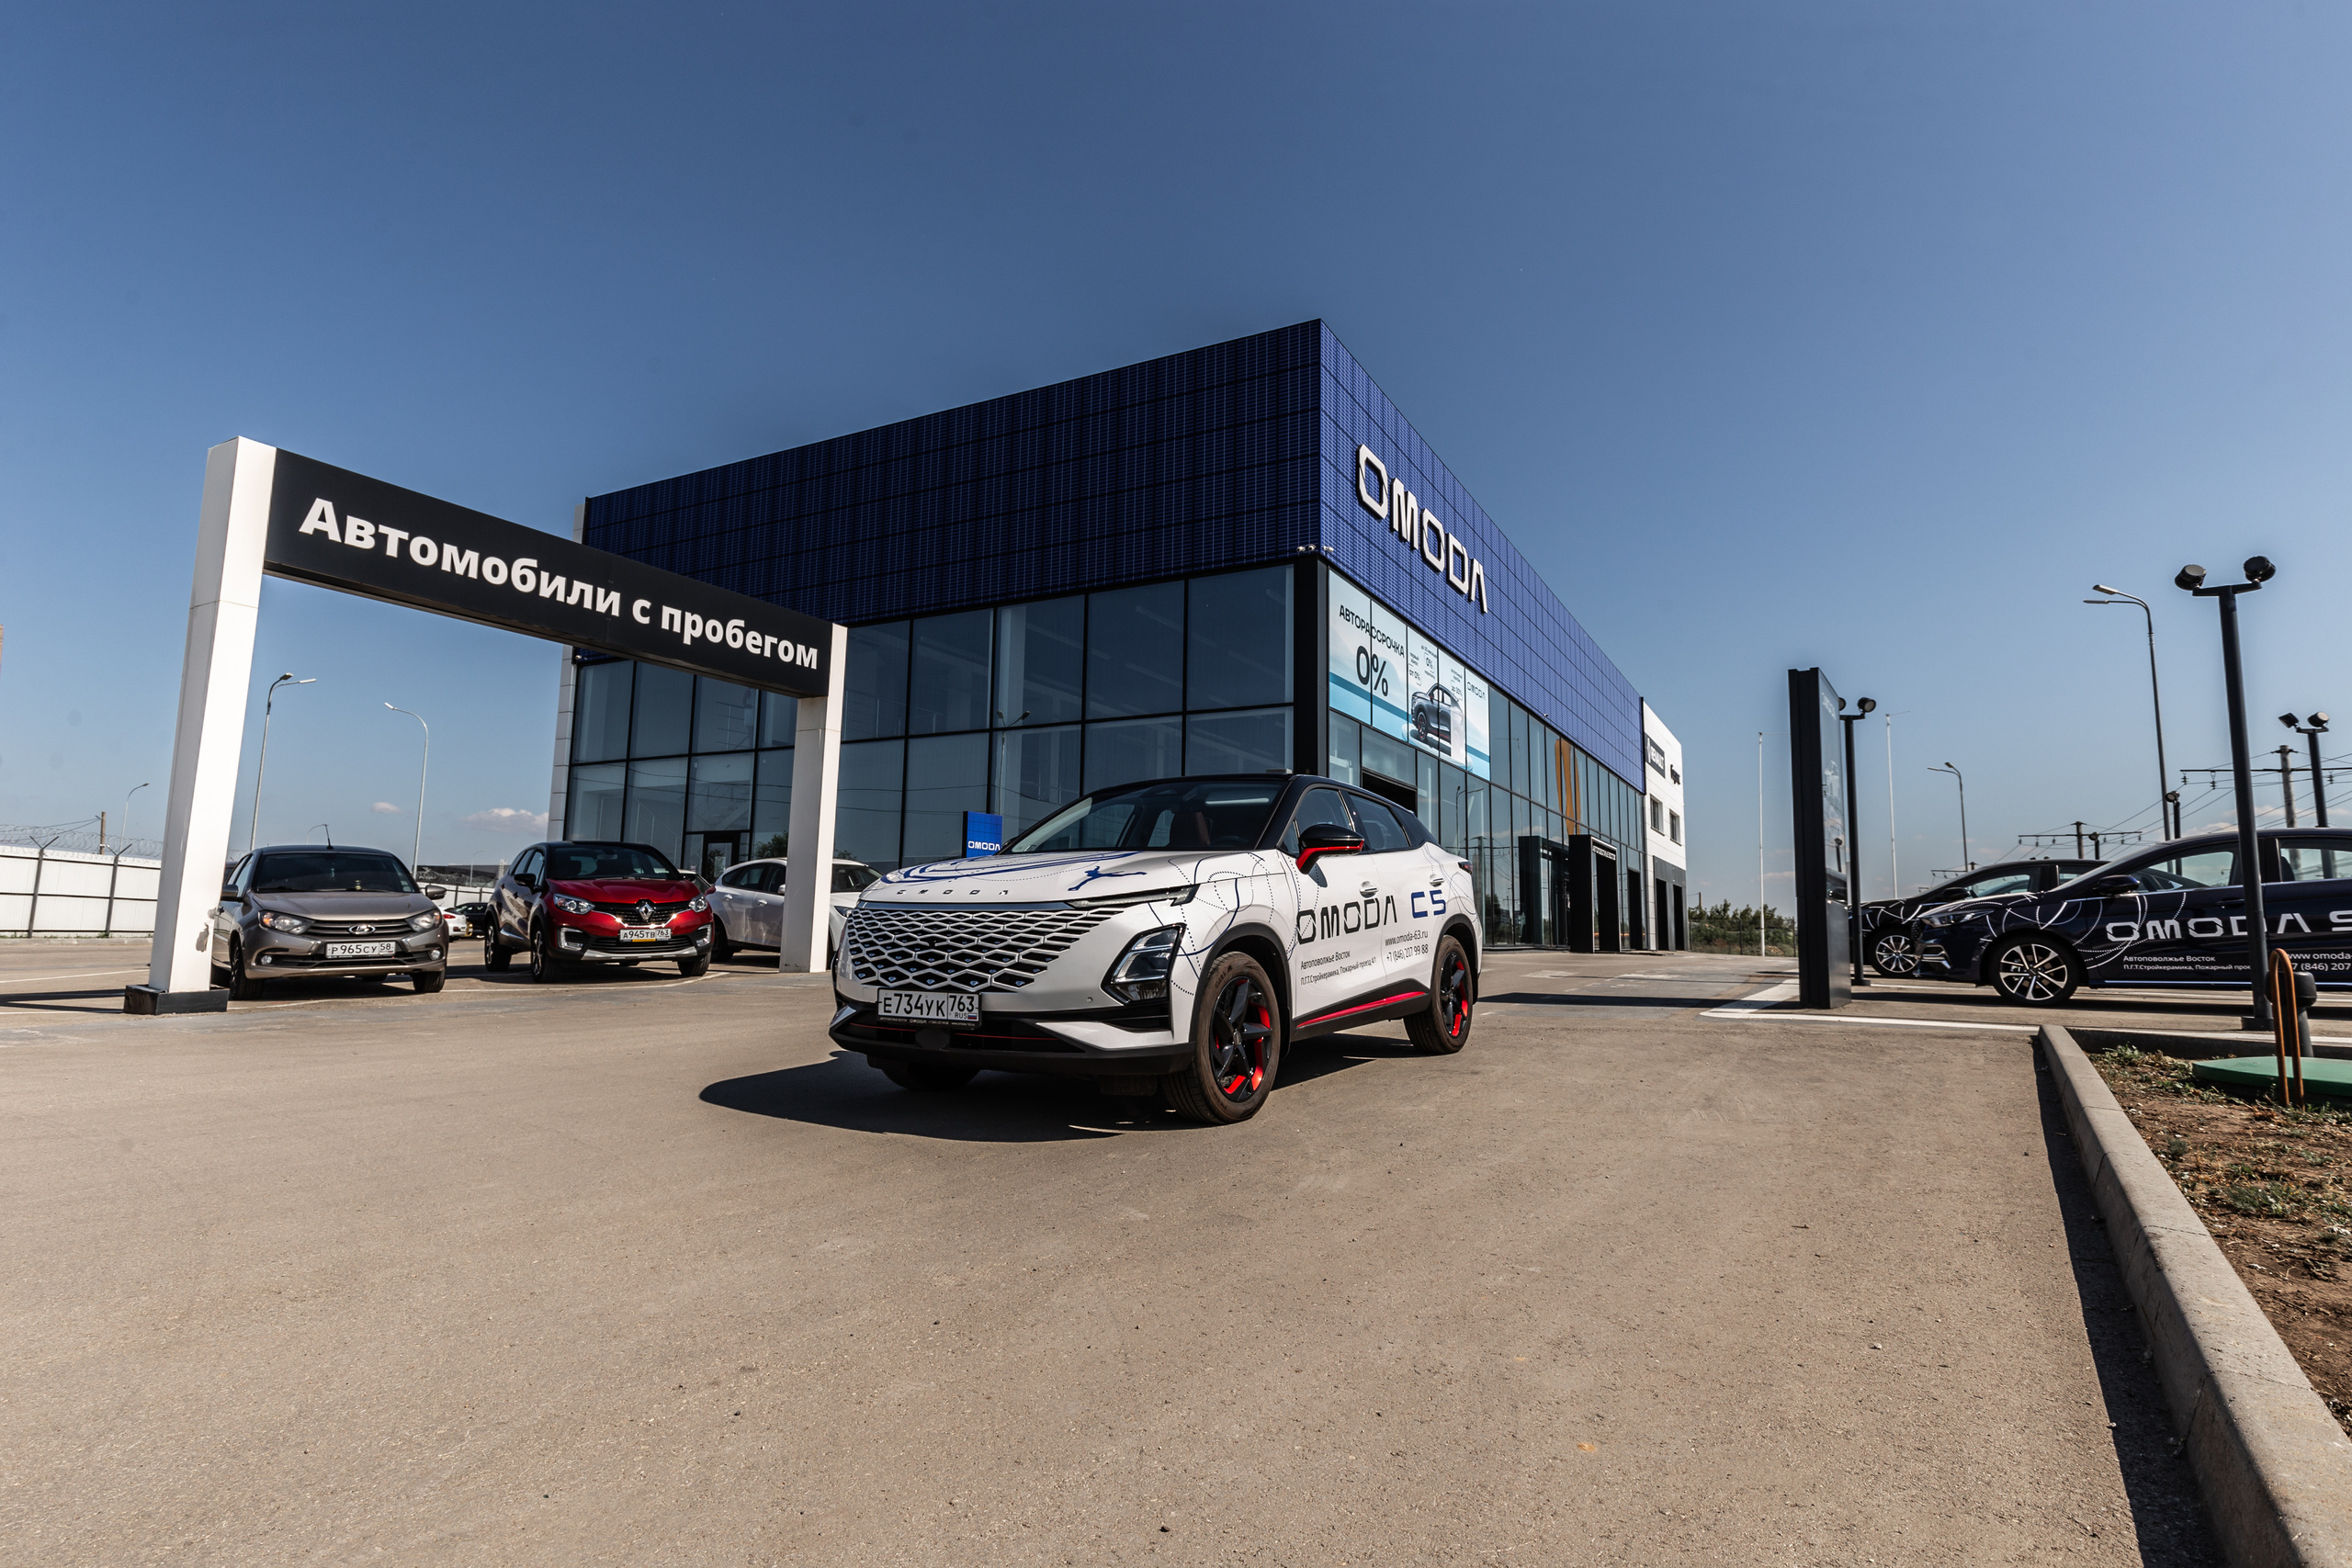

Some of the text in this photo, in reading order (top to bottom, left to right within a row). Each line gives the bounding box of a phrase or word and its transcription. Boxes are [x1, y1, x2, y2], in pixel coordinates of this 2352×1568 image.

[1356, 444, 1487, 614] OMODA
[299, 498, 819, 670] Автомобили с пробегом
[1340, 604, 1405, 658] АВТОРАССРОЧКА
[1356, 646, 1388, 697] 0%
[968, 840, 1001, 851] OMODA
[1296, 889, 1446, 945] OMODA C5
[1385, 930, 1429, 946] www.omoda-63.ru
[332, 944, 377, 954] Р965СУ
[1414, 945, 1420, 955] 99
[1421, 943, 1429, 954] 88
[1300, 951, 1351, 970] Автоповолжье Восток
[2301, 963, 2328, 972] (846)
[2331, 963, 2351, 971] 207
[883, 993, 975, 1017] Е734УК 763
